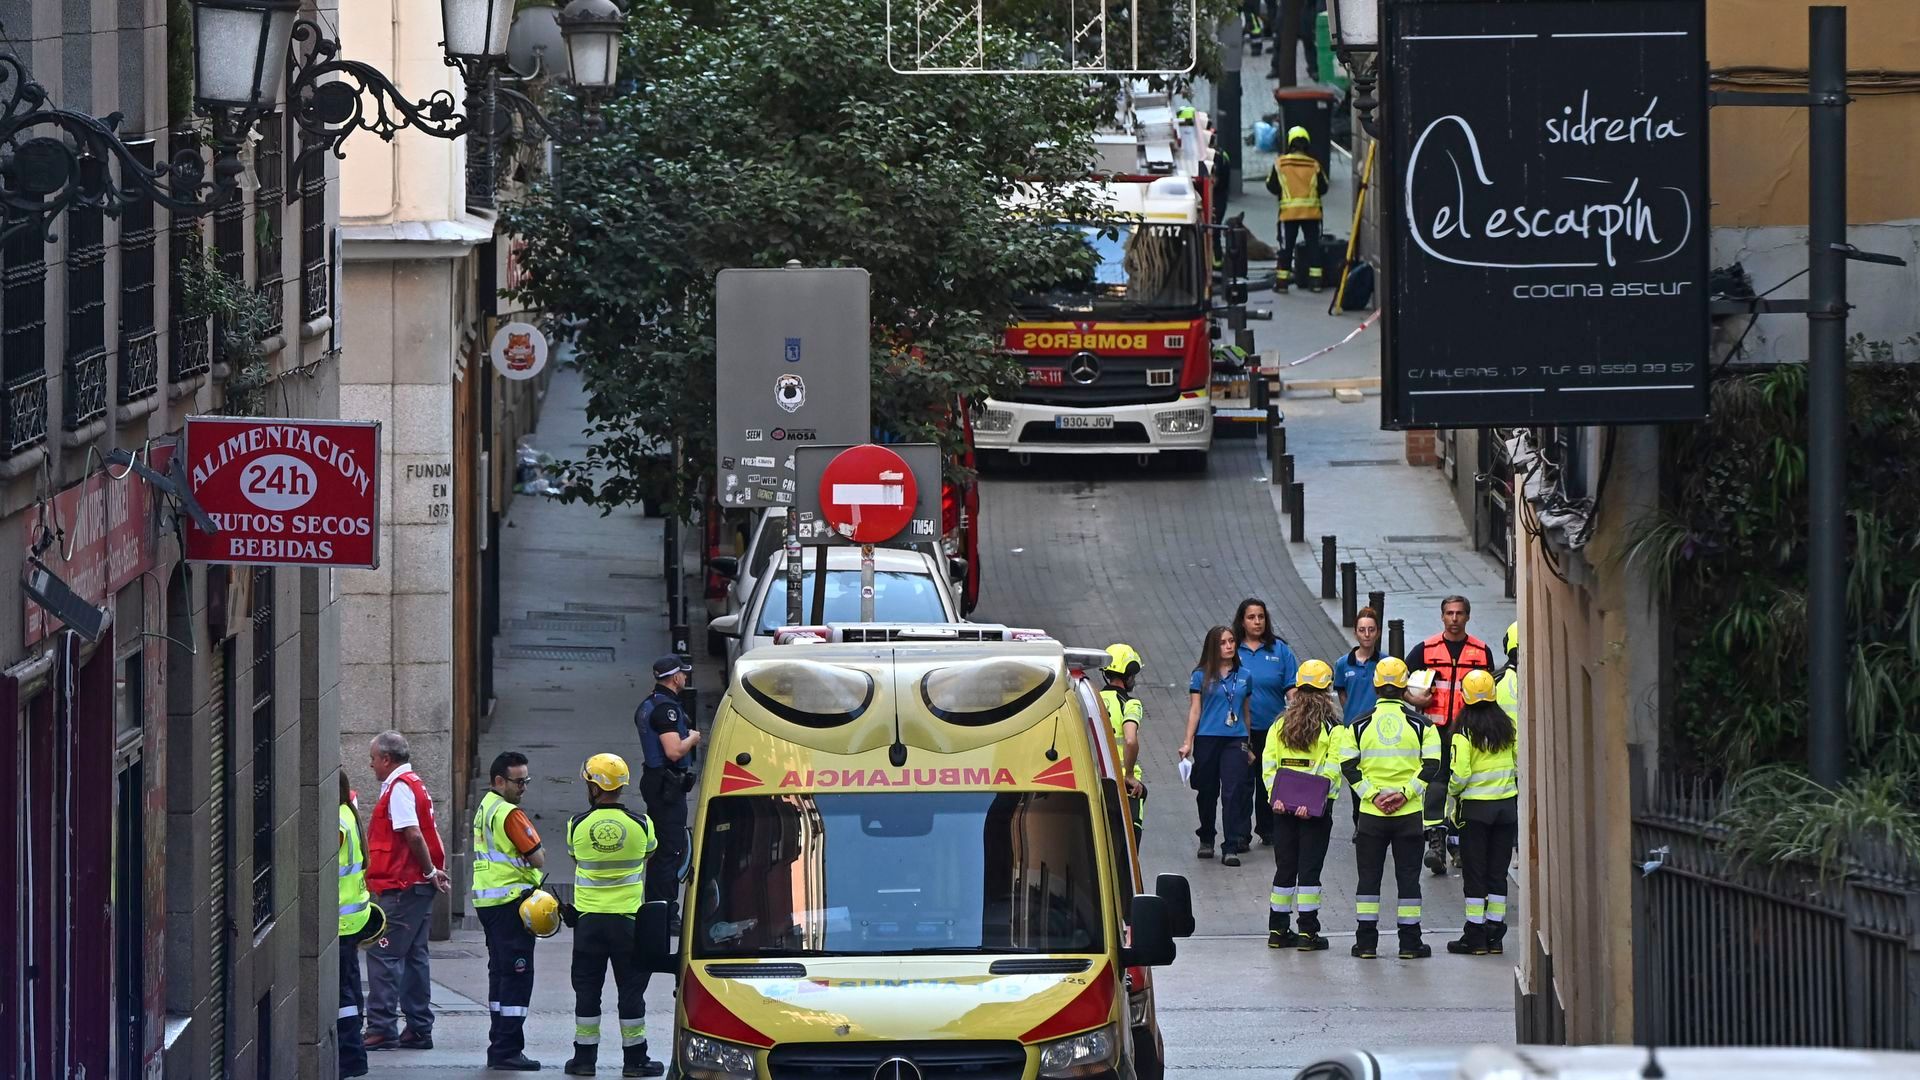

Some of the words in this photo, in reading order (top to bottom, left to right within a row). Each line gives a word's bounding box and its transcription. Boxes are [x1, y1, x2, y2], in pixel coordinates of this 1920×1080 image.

[1546, 89, 1688, 145] sidrería
[1432, 149, 1471, 239] el
[1485, 177, 1662, 267] escarpín
[1149, 225, 1181, 237] 1717
[1513, 283, 1604, 299] cocina
[1610, 281, 1692, 296] astur
[1408, 368, 1425, 379] C/
[1511, 366, 1528, 376] 17
[1539, 365, 1572, 375] TLF
[1578, 365, 1596, 375] 91
[1600, 364, 1637, 374] 559
[1671, 363, 1695, 372] 57
[1063, 416, 1089, 428] 9304
[1092, 415, 1112, 428] JGV
[787, 432, 816, 441] MOSA
[192, 425, 371, 498] ALIMENTACIÓN
[248, 464, 310, 495] 24h
[432, 483, 447, 498] EN
[291, 515, 371, 536] SECOS
[912, 519, 934, 535] TM54
[229, 538, 333, 559] BEBIDAS
